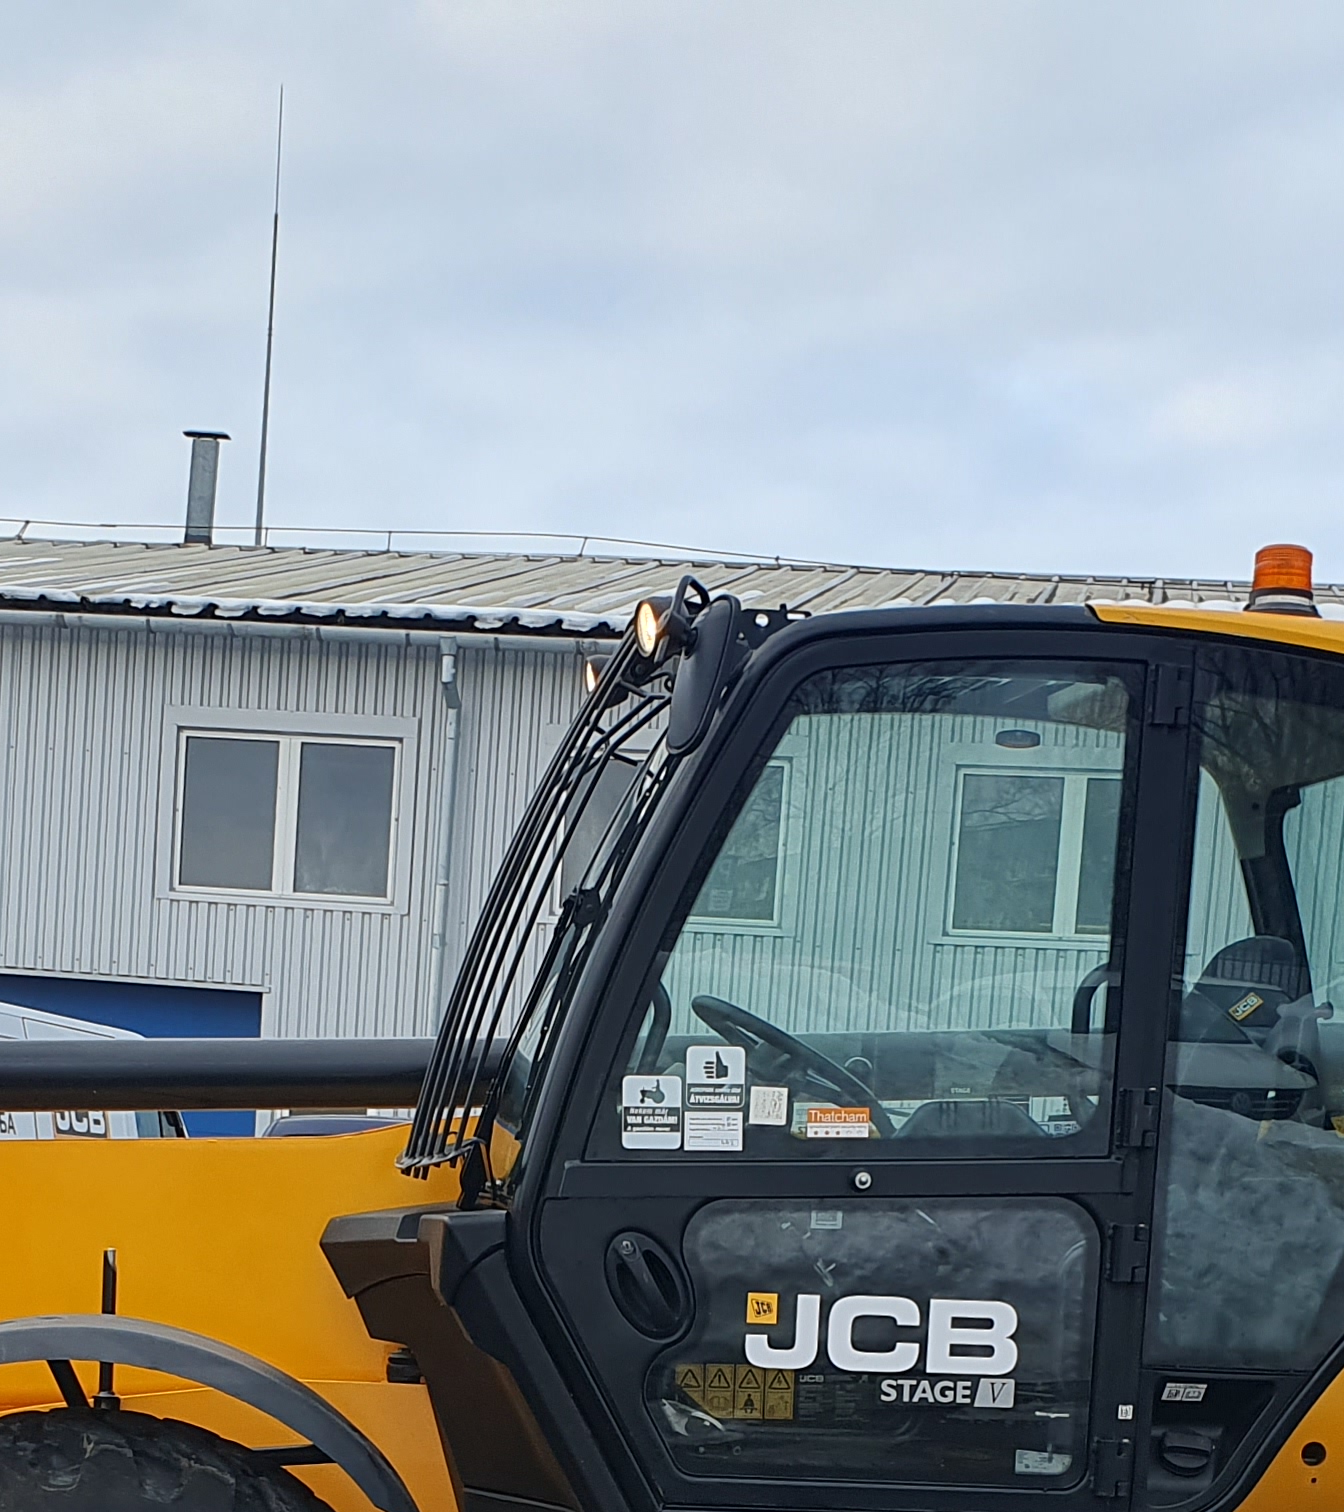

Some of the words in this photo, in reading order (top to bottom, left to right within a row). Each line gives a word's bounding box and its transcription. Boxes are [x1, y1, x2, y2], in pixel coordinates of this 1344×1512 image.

[808, 1109, 867, 1122] Thatcham
[744, 1293, 1019, 1376] JCB
[880, 1379, 972, 1405] STAGE
[987, 1382, 1008, 1404] V
